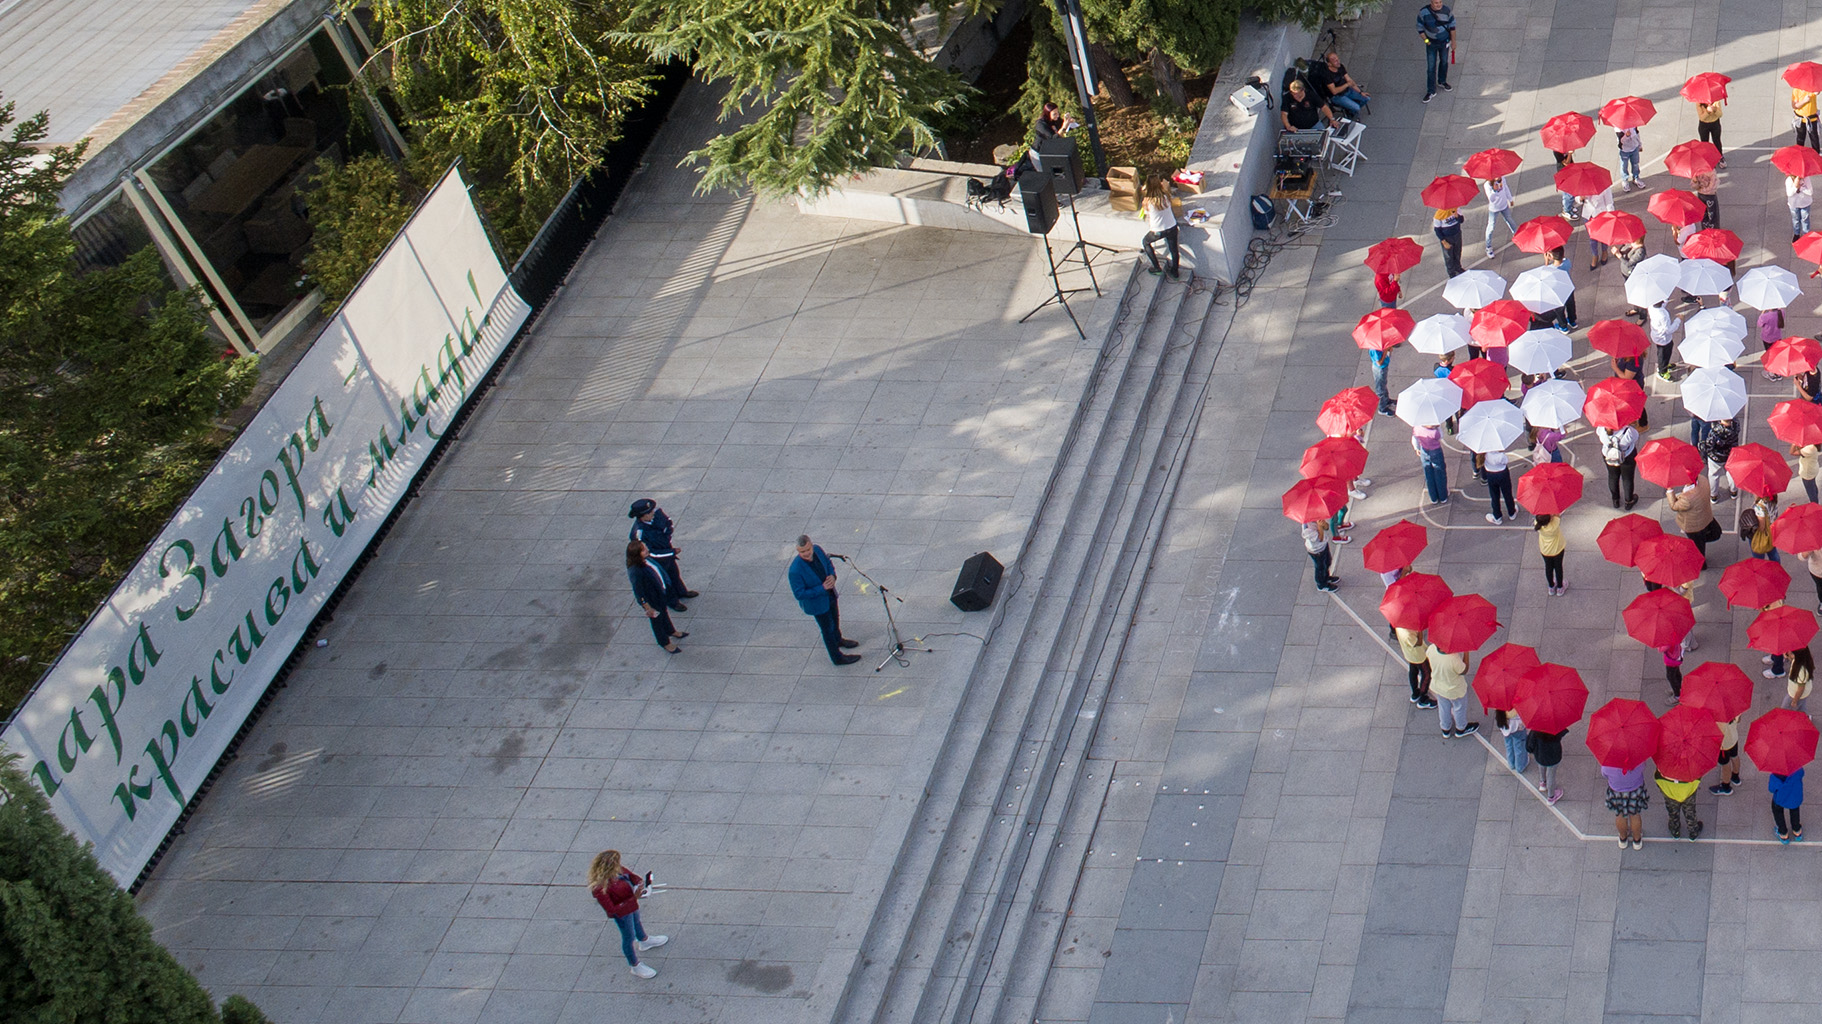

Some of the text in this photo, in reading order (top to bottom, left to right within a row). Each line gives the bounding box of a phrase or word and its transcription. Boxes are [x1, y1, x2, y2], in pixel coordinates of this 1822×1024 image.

[110, 268, 491, 822] красива и млада!
[158, 395, 334, 622] Загора
